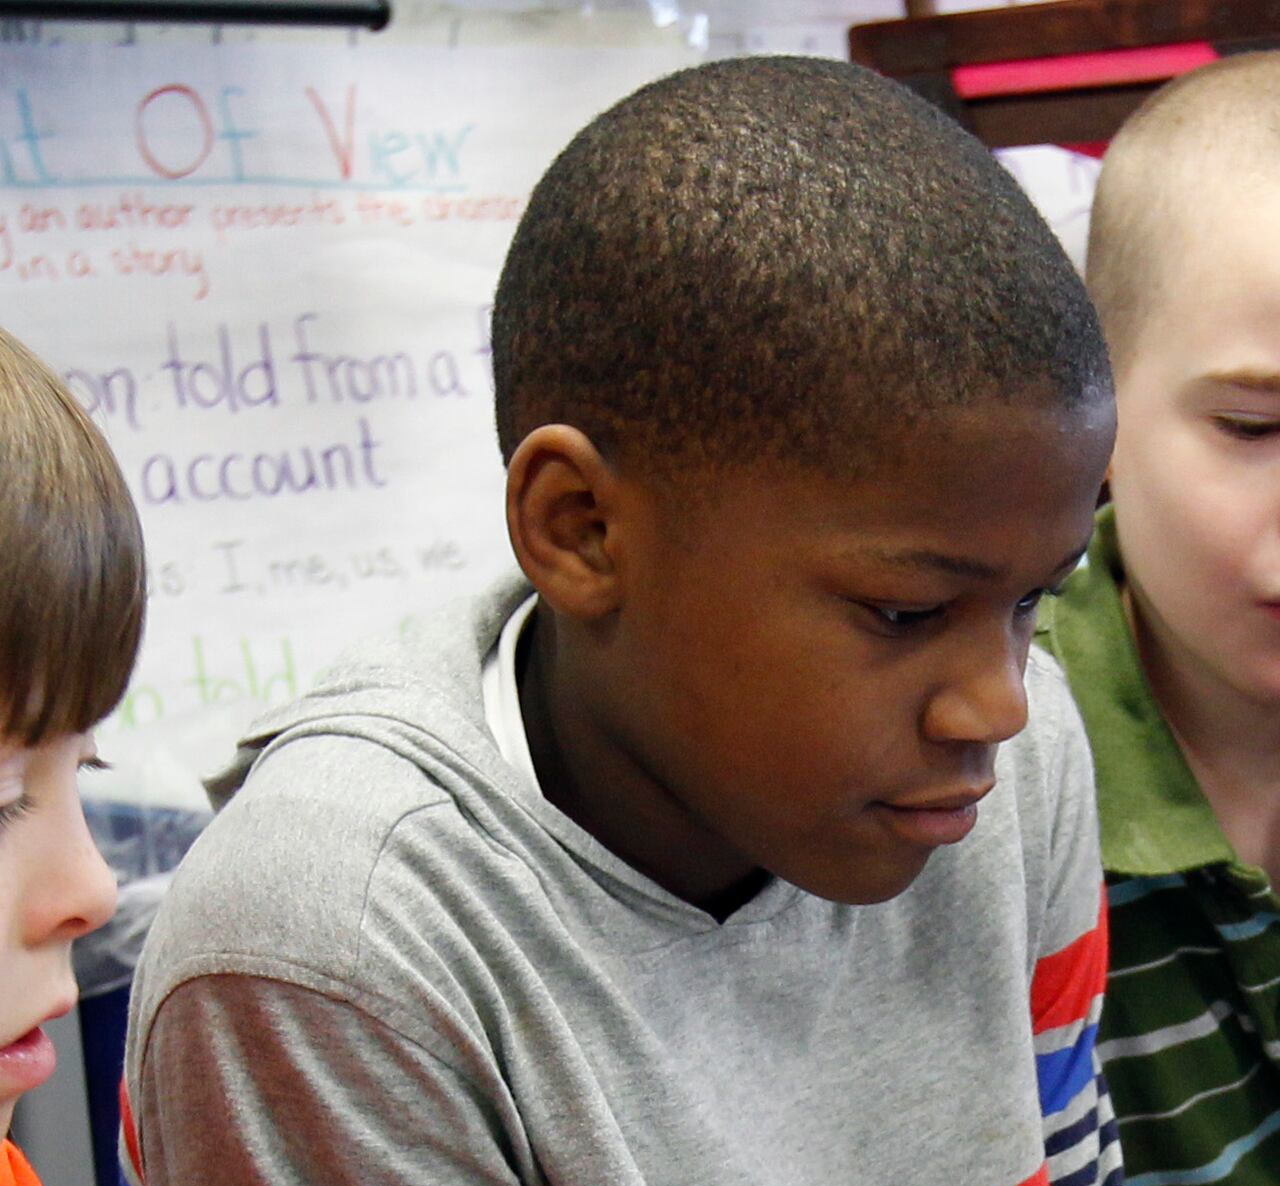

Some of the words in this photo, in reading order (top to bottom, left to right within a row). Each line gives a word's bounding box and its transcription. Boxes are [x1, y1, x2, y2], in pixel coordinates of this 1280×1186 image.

[135, 83, 258, 182] Of
[304, 83, 477, 186] View
[162, 320, 280, 412] told
[292, 312, 418, 402] from
[427, 349, 472, 398] a
[141, 416, 390, 505] account
